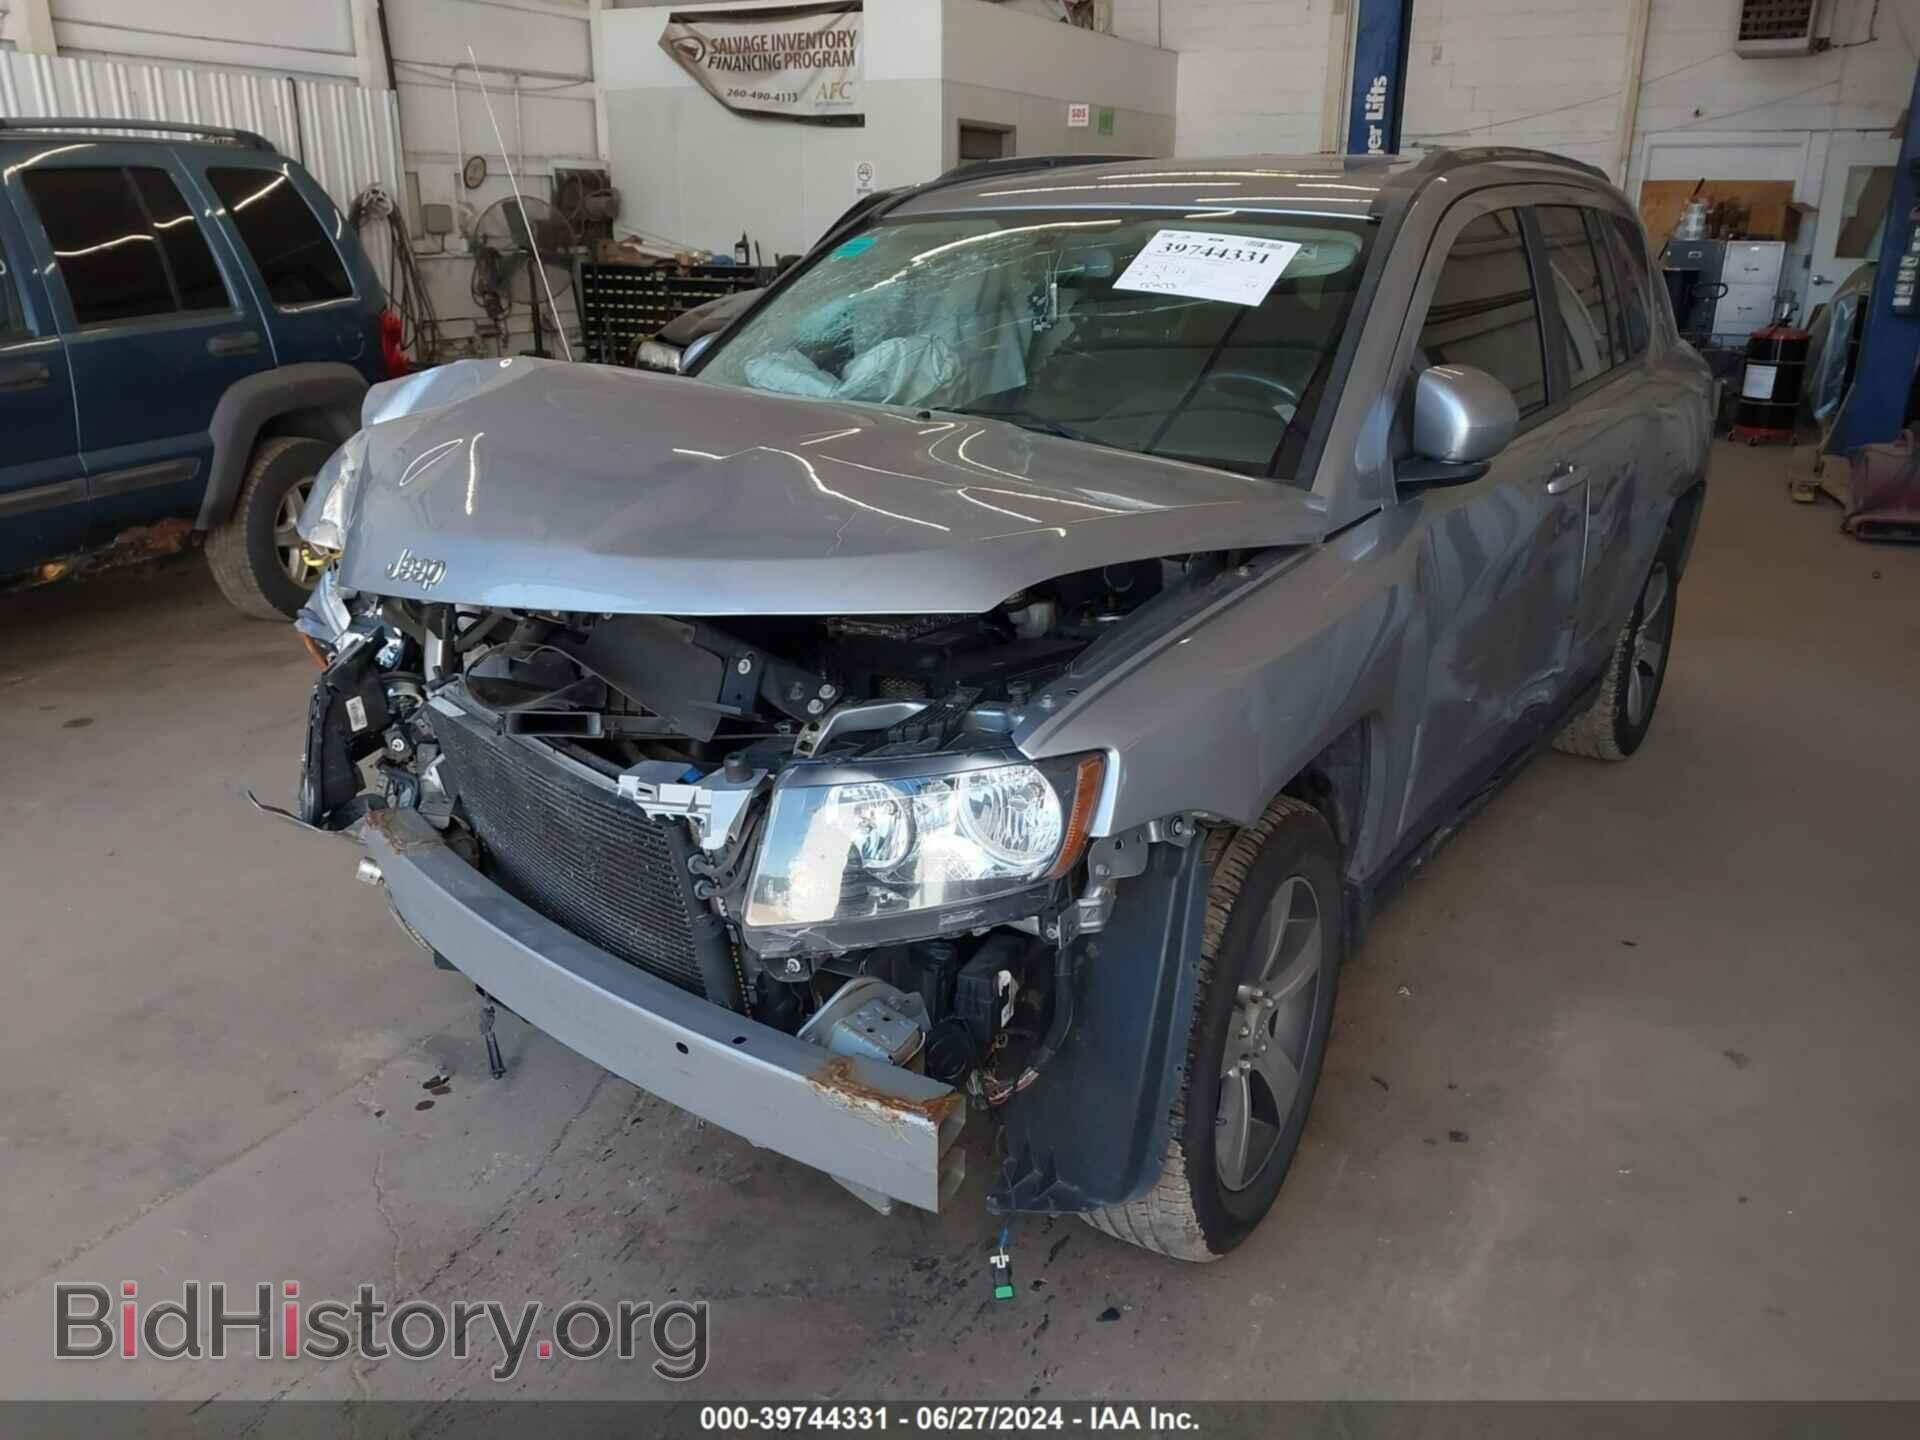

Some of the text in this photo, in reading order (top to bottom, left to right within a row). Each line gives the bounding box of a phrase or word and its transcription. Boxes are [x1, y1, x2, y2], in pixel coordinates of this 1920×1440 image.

[709, 30, 857, 55] SALVAGE INVENTORY
[707, 47, 856, 72] FINANCING PROGRAM
[726, 87, 799, 103] 260-490-4113
[815, 80, 853, 100] AFC
[1364, 75, 1388, 120] Lifts
[1156, 242, 1270, 265] 39744331
[385, 548, 448, 592] Jeep
